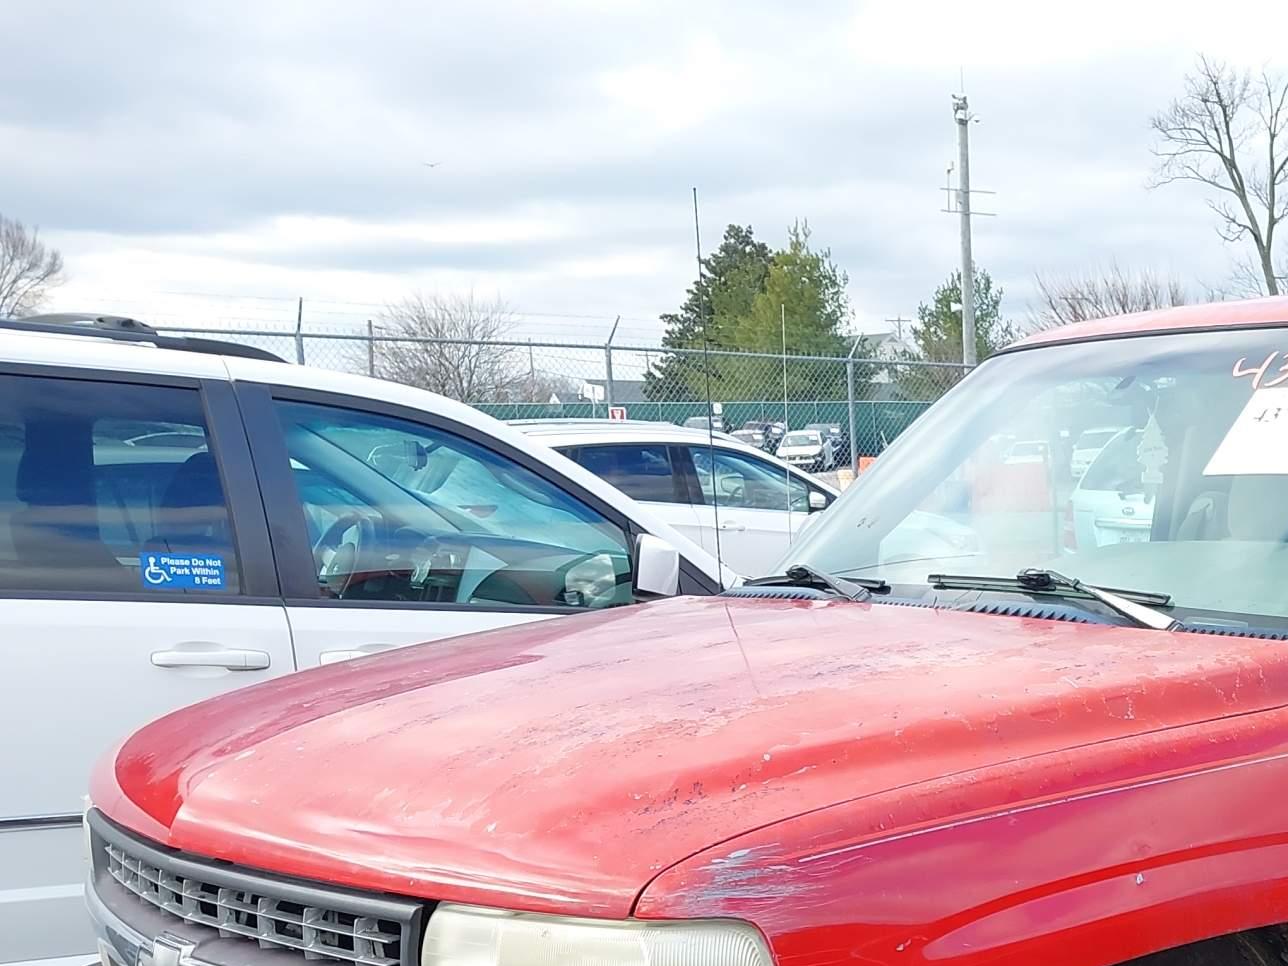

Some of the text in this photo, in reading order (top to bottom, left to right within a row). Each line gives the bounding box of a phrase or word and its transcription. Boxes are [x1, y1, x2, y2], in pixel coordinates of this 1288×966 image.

[160, 557, 221, 567] Please Do Not
[170, 566, 219, 576] Park Within
[202, 577, 221, 585] Feet
